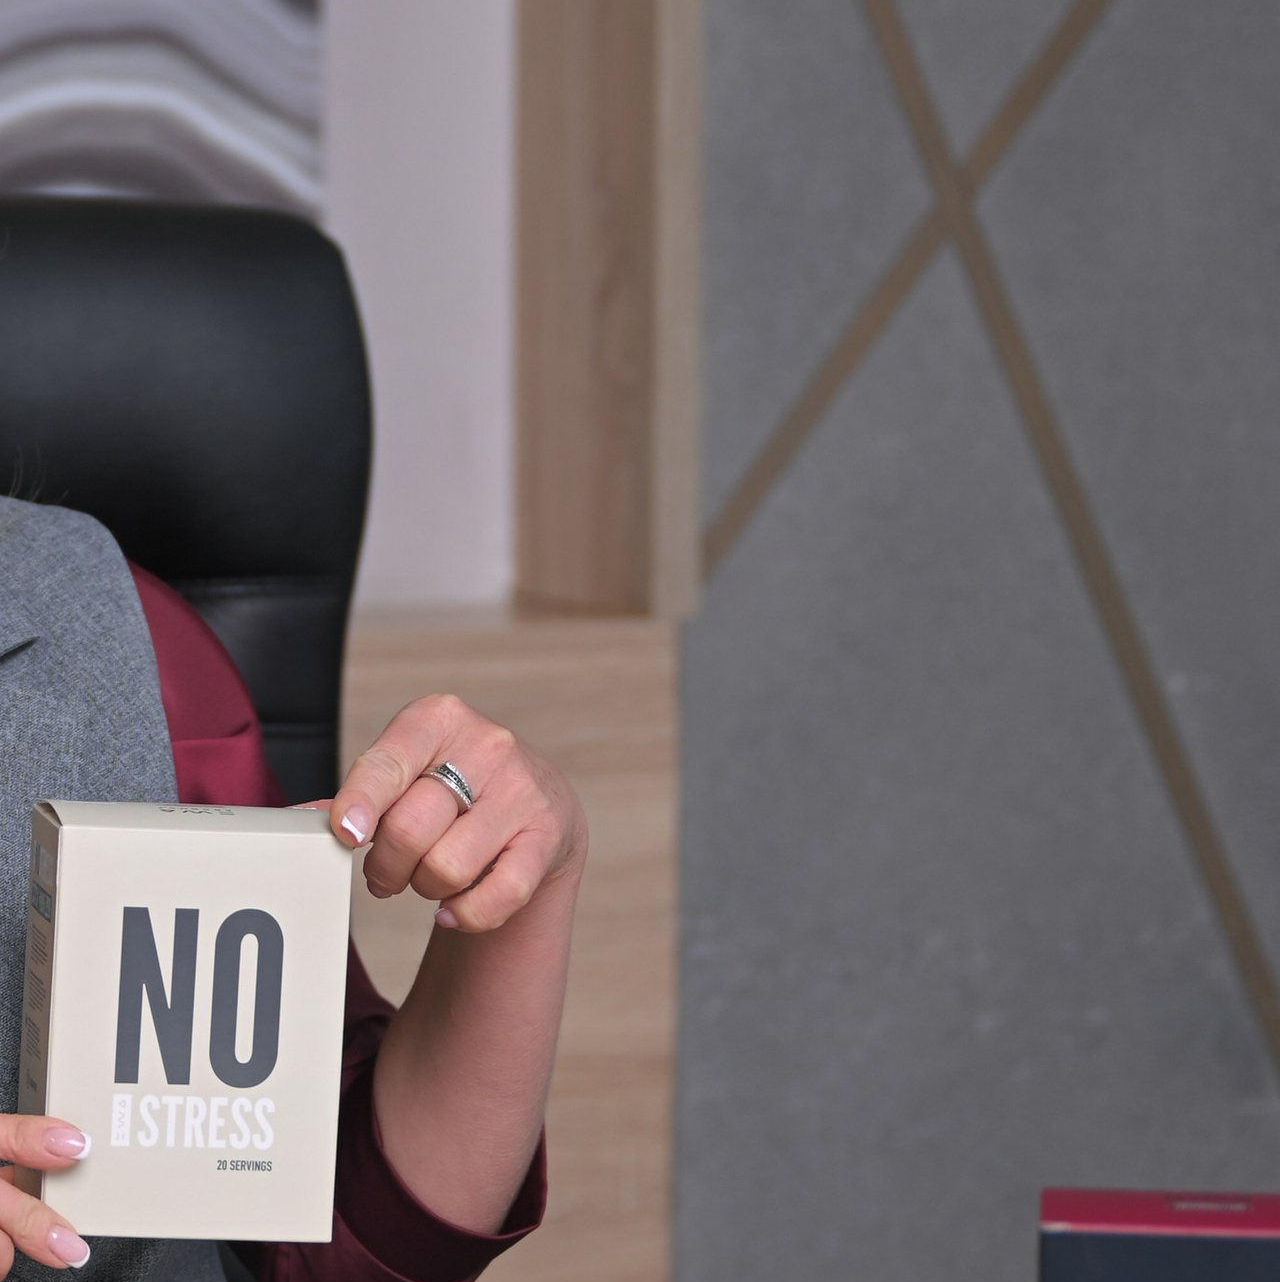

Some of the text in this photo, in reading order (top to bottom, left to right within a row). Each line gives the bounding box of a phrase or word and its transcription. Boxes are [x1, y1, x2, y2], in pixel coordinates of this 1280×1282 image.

[114, 906, 284, 1088] NO
[136, 1093, 276, 1150] STRESS
[216, 1159, 273, 1172] 20 SERVINGS
